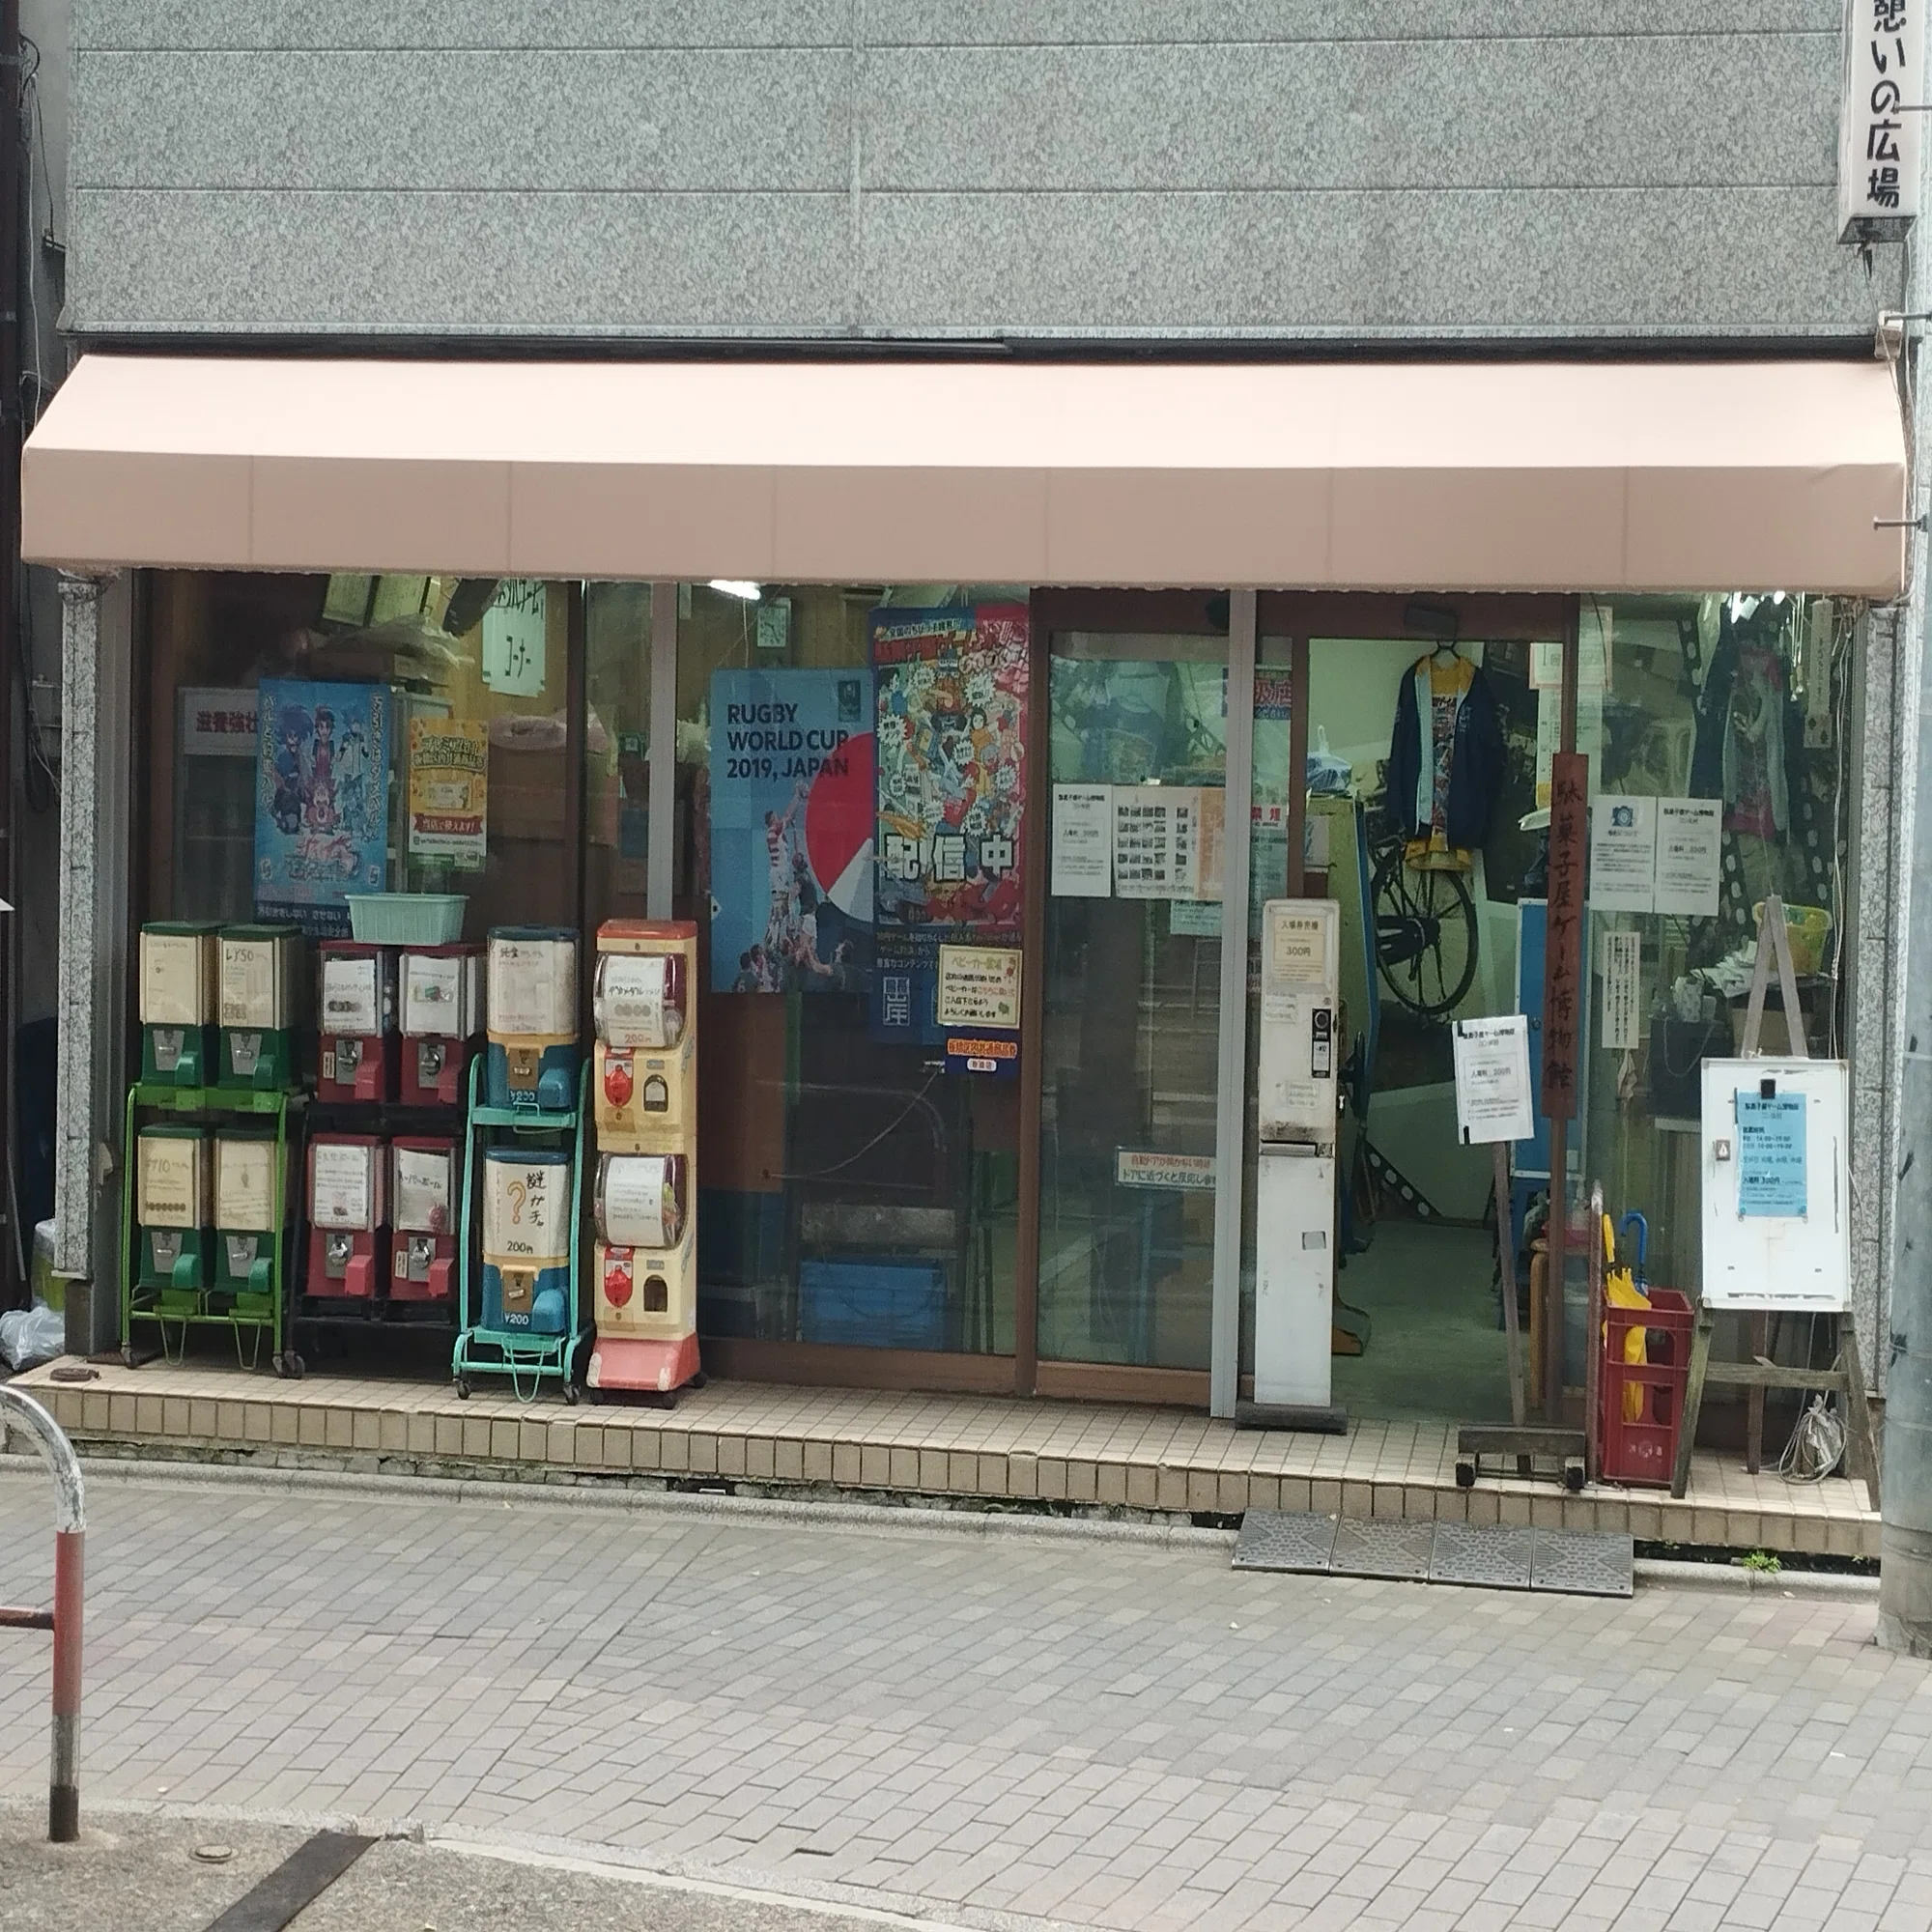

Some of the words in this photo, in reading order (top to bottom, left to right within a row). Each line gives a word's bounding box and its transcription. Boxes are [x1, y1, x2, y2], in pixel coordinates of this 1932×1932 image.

[727, 703, 799, 724] RUGBY
[726, 730, 803, 752] WORLD
[807, 729, 849, 752] CUP
[726, 758, 778, 781] 2019,
[781, 757, 849, 778] JAPAN
